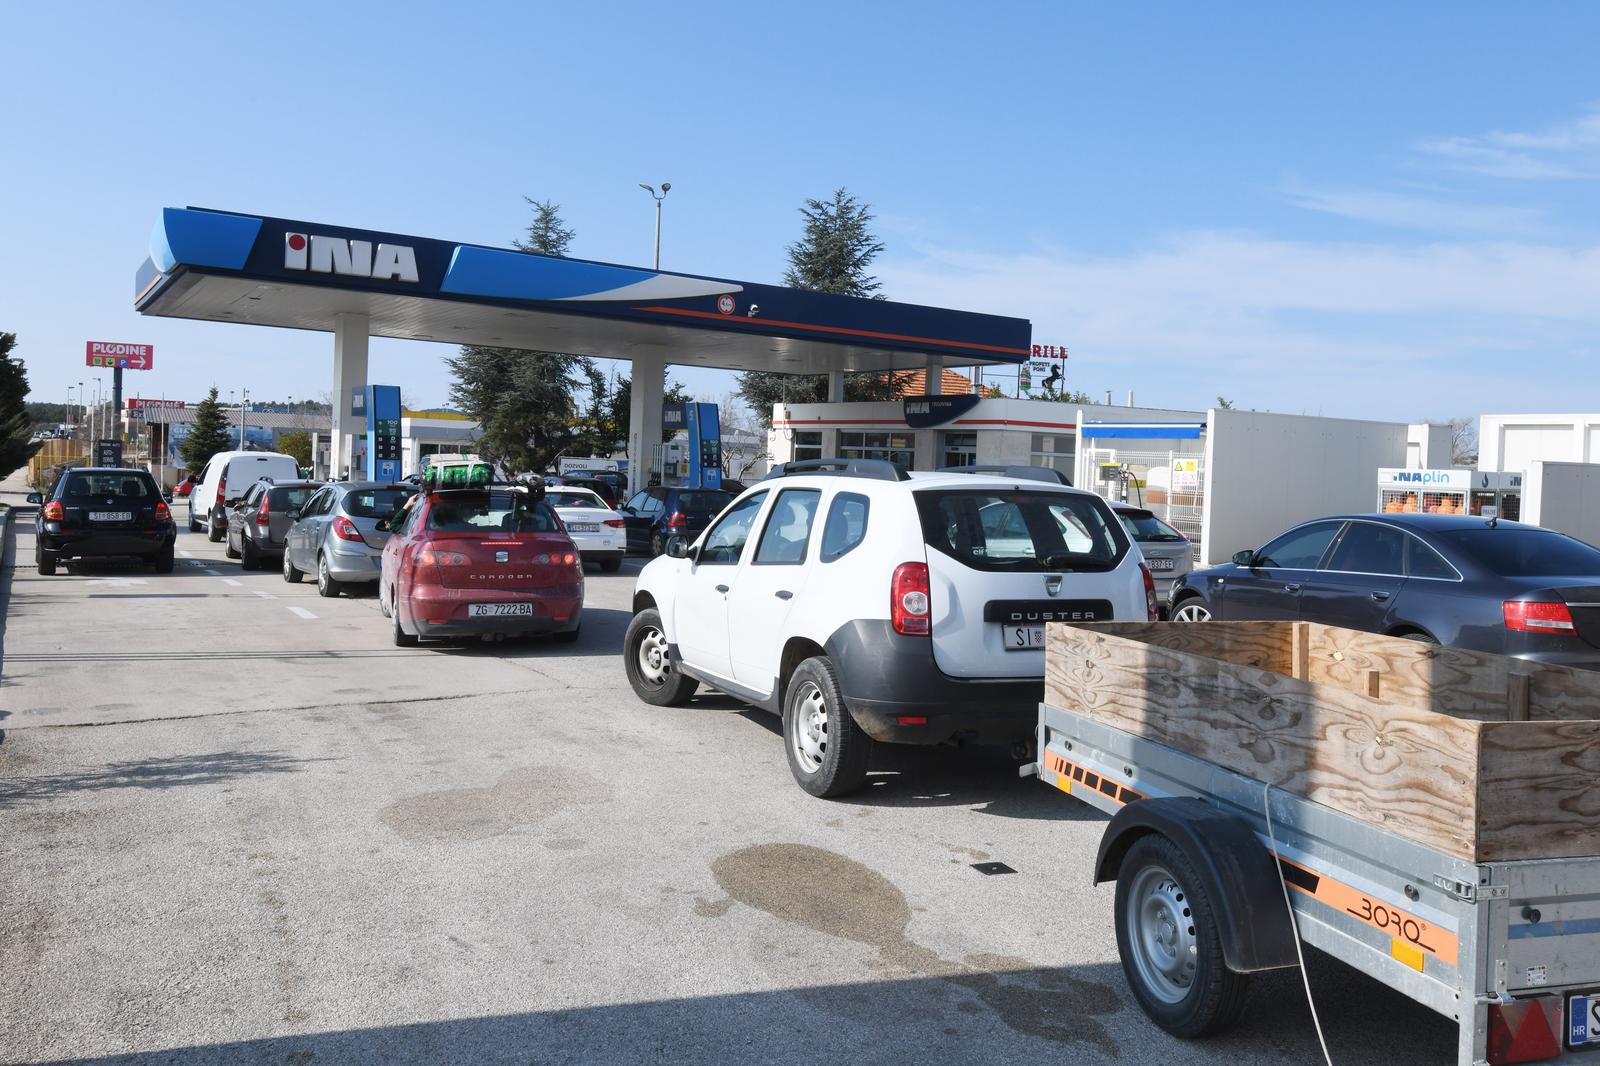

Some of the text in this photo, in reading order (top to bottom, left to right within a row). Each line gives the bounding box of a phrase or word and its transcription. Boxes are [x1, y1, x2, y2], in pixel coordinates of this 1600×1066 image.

[284, 231, 420, 282] INA
[92, 343, 147, 356] PLODINE
[1030, 344, 1069, 359] RILL
[475, 605, 488, 616] ZG
[1011, 611, 1095, 621] DUSTER
[1572, 1025, 1586, 1037] HR
